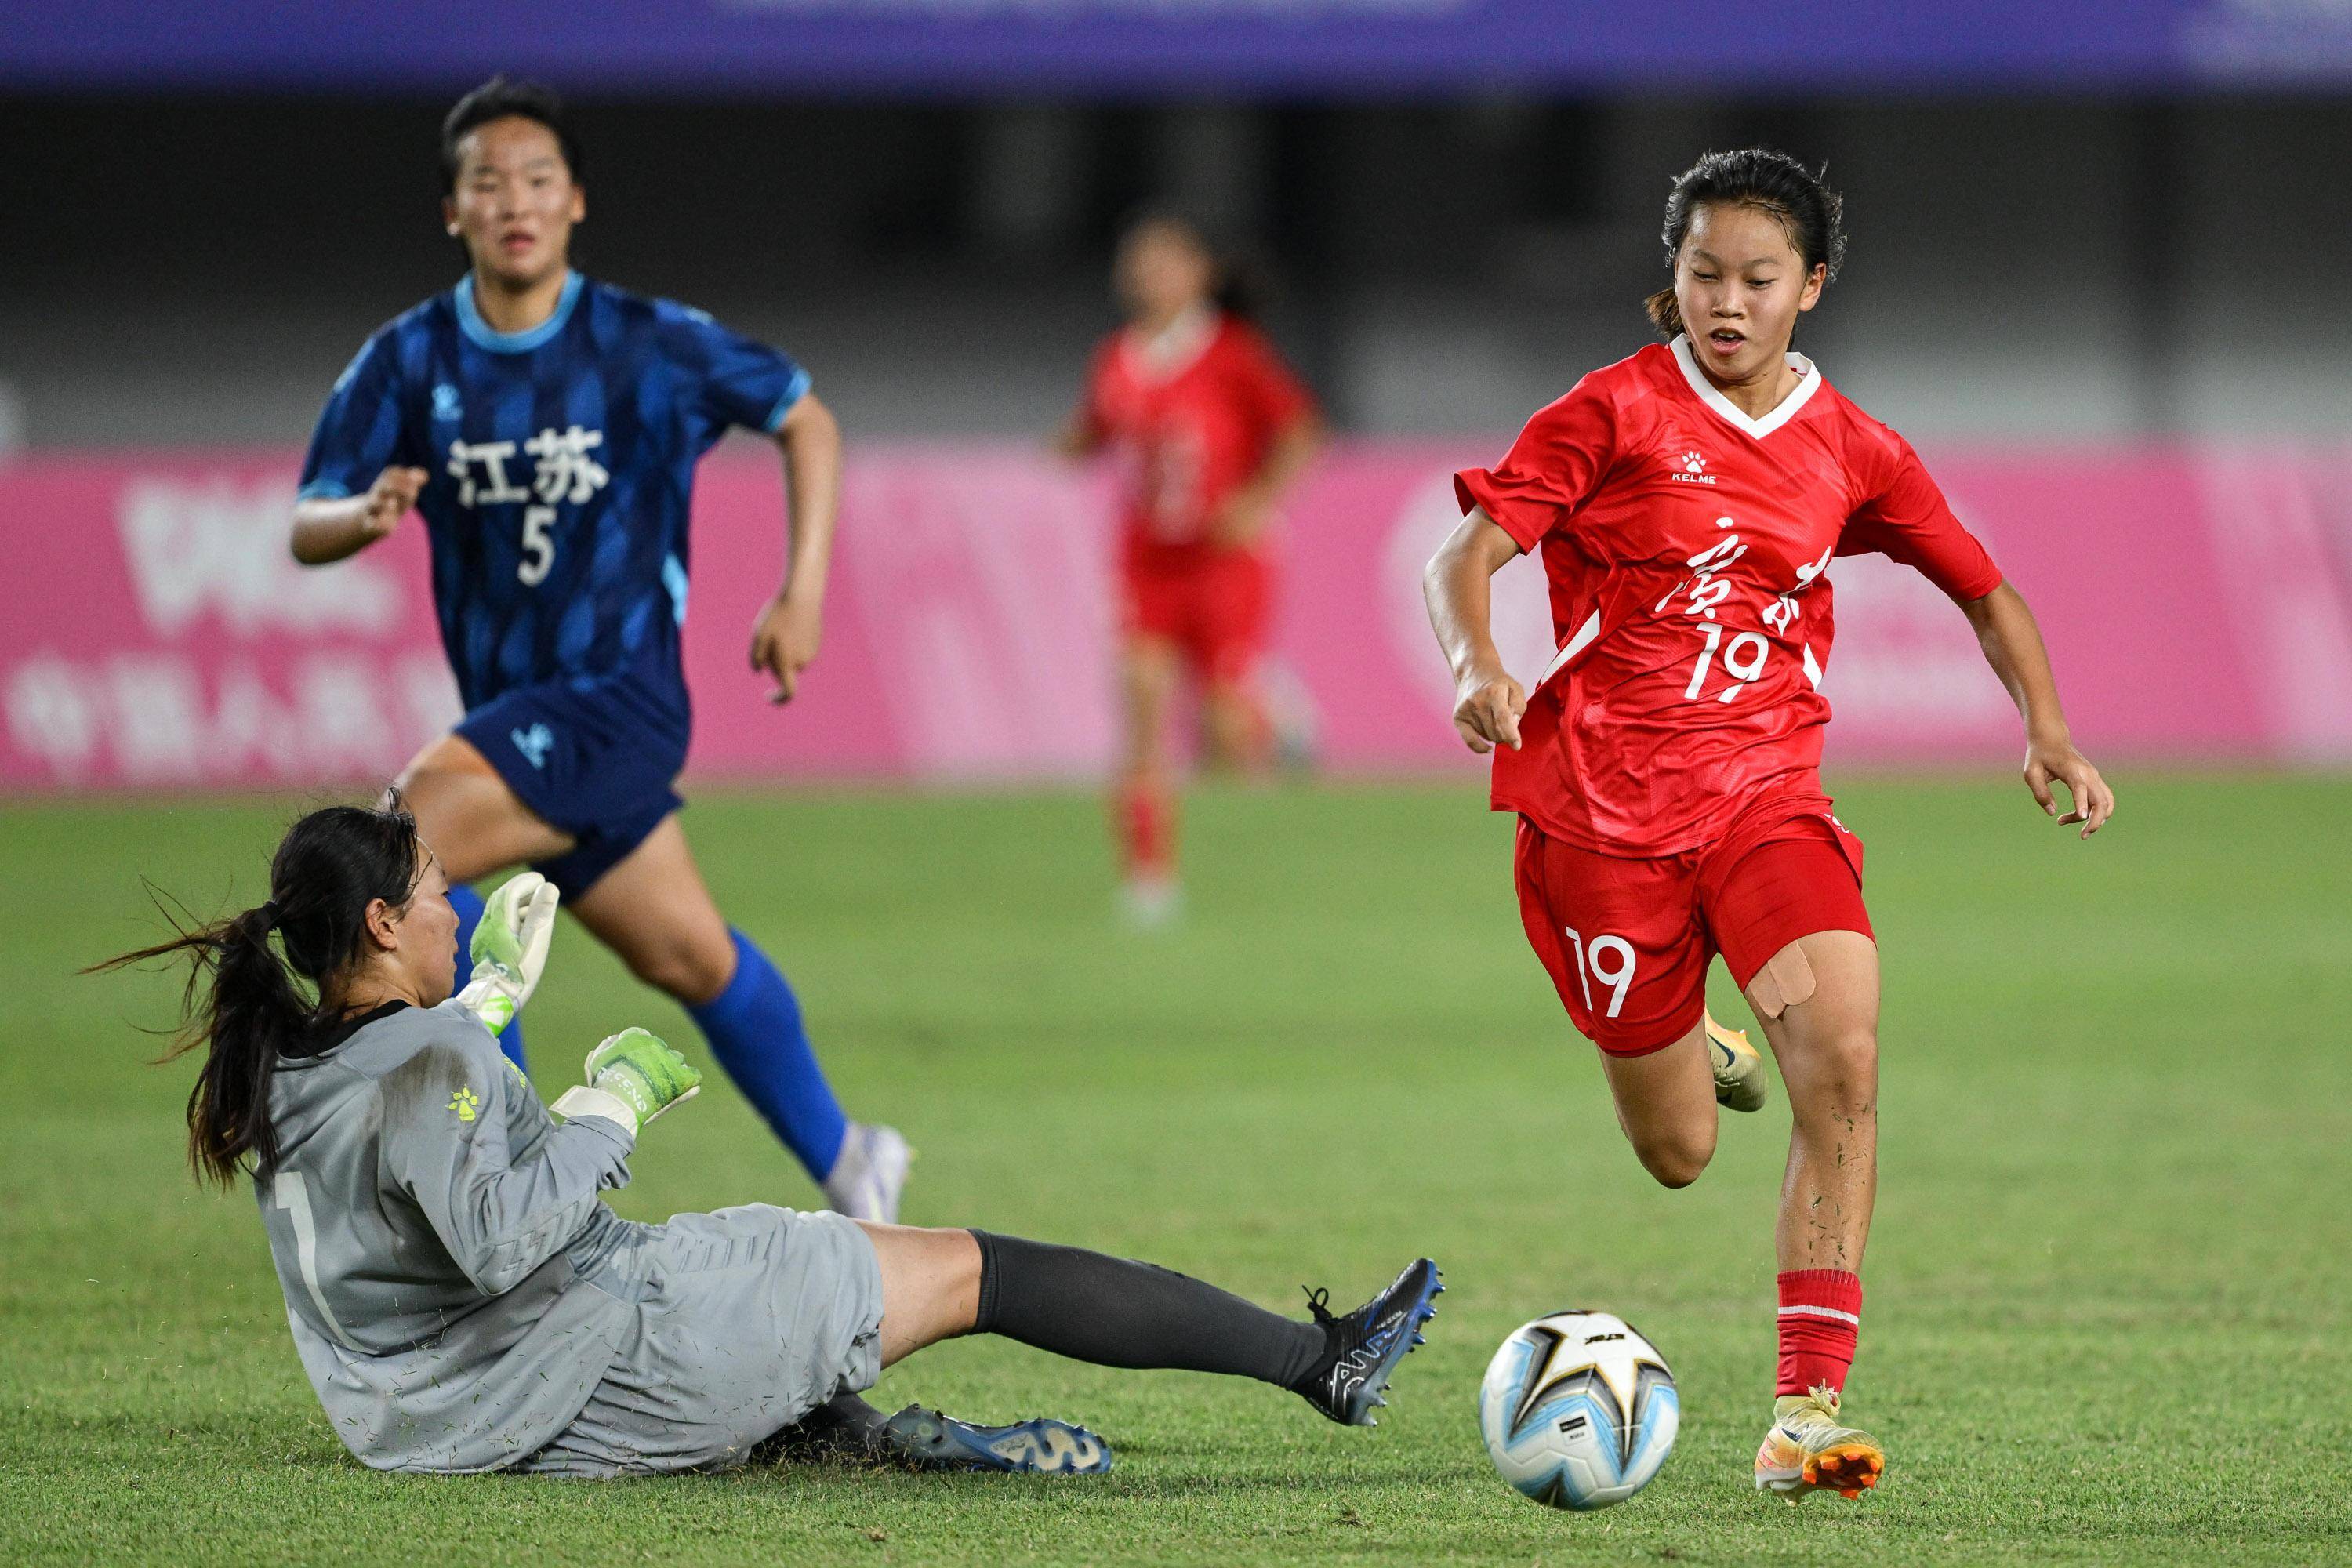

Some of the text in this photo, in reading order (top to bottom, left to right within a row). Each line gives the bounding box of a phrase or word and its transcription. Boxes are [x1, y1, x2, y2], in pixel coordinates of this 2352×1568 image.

[448, 425, 610, 508] 江苏
[1672, 473, 1716, 485] KELME
[517, 505, 557, 586] 5
[1685, 622, 1769, 703] 19
[1566, 927, 1637, 1017] 19
[275, 1171, 381, 1355] 1
